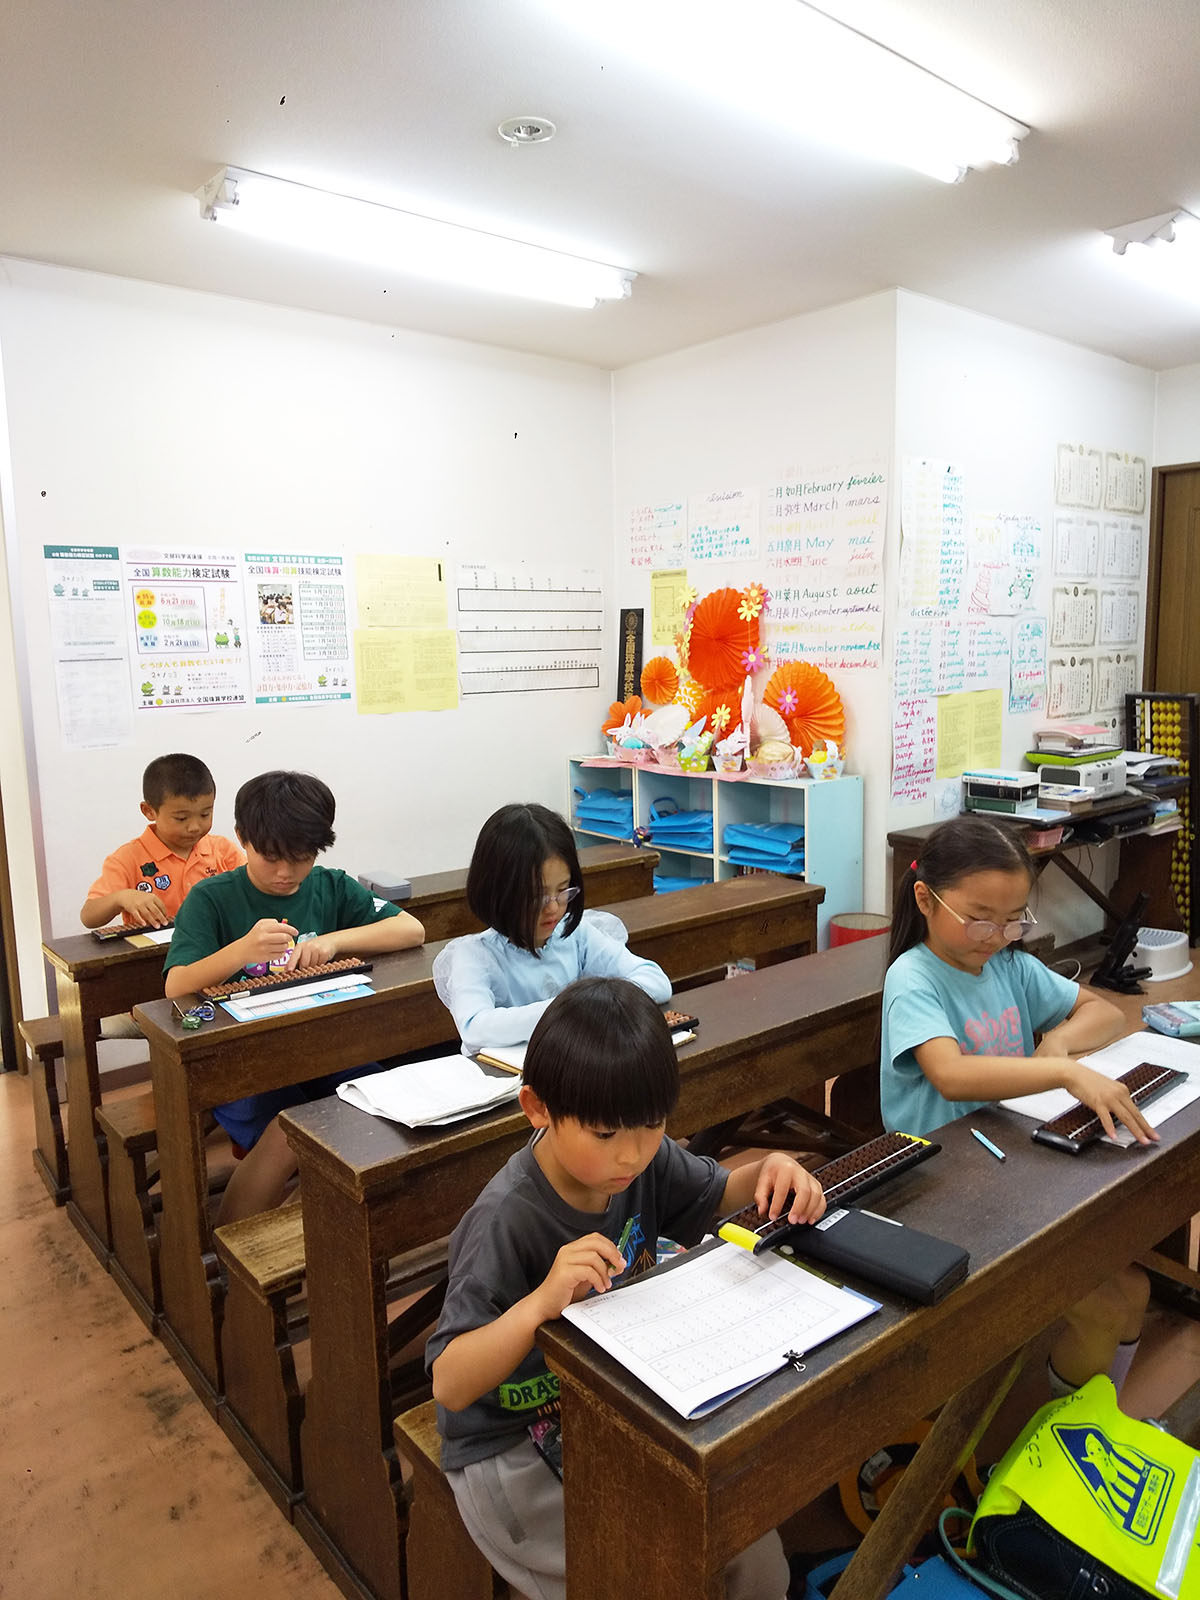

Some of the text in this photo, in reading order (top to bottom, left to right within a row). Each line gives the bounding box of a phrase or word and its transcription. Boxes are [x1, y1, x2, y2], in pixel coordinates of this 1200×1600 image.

[804, 481, 844, 494] February
[804, 497, 838, 512] March
[806, 536, 834, 550] May
[848, 530, 874, 546] mai
[805, 555, 828, 567] June
[802, 588, 838, 603] August
[800, 604, 841, 621] September
[800, 640, 838, 652] November
